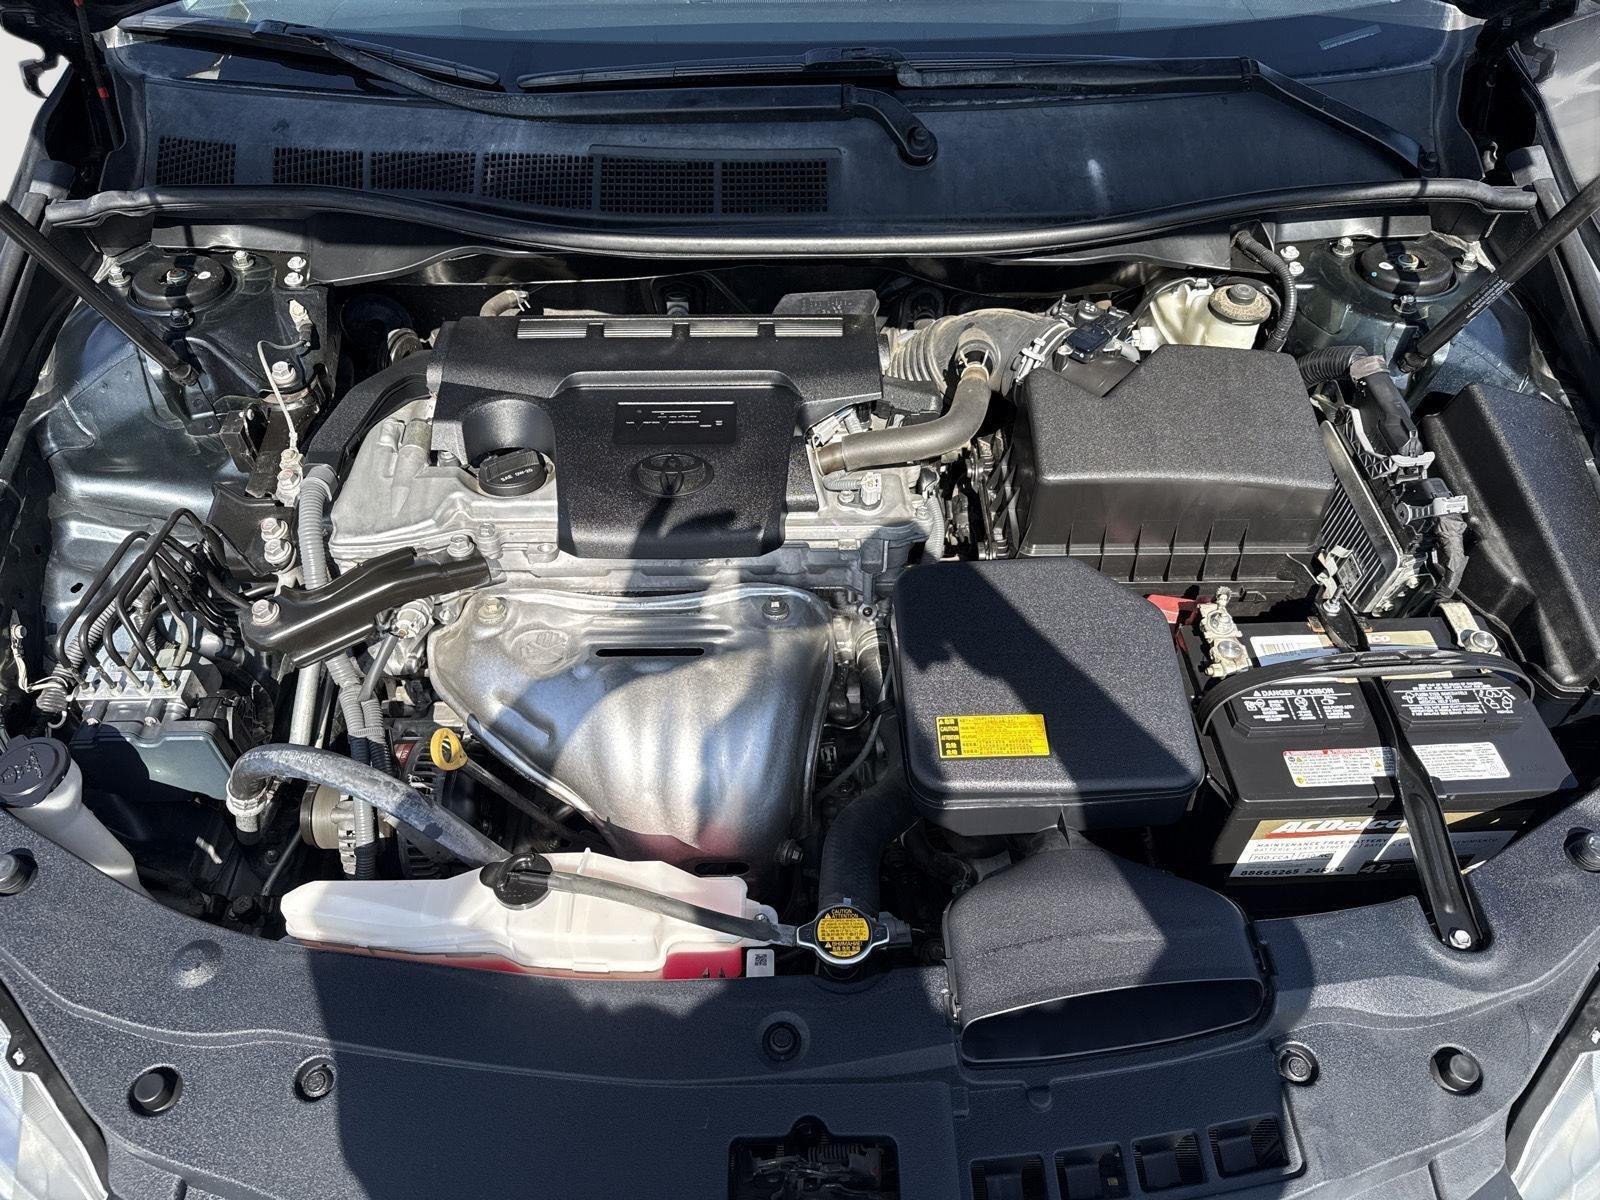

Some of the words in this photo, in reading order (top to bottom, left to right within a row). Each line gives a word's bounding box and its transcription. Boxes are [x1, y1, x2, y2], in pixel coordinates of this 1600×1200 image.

[1261, 689, 1296, 697] DANGER
[1303, 687, 1335, 695] POISON
[1271, 817, 1404, 833] ACDelco
[1361, 863, 1391, 873] 42
